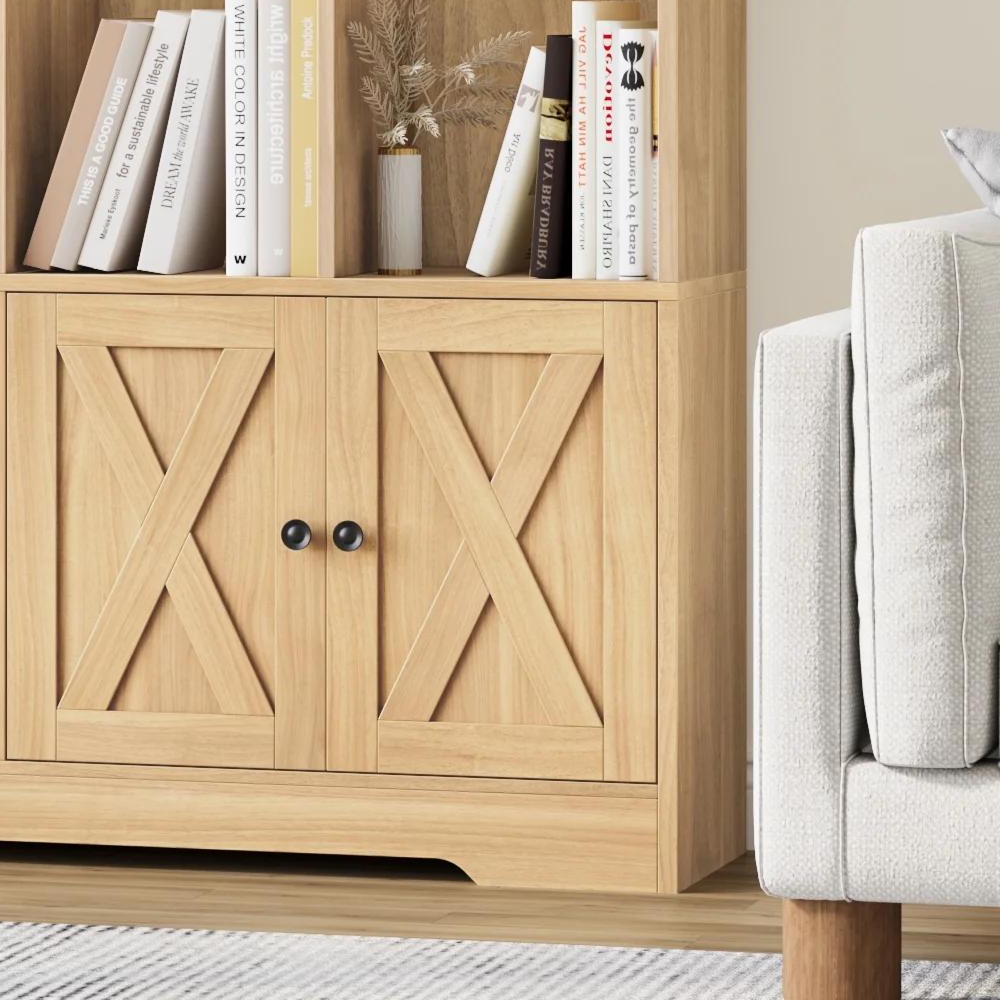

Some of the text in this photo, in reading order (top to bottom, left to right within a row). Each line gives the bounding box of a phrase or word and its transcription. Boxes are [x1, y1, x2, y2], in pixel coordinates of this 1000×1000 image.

[116, 43, 170, 178] for a sustainable lifestyle
[234, 4, 246, 218] WHITE COLOR IN DESIGN
[300, 16, 312, 100] Antoine Predock
[77, 76, 128, 206] THIS IS A GOOD GUIDE
[161, 78, 200, 209] DREAM the world AWAKE
[234, 255, 246, 264] W
